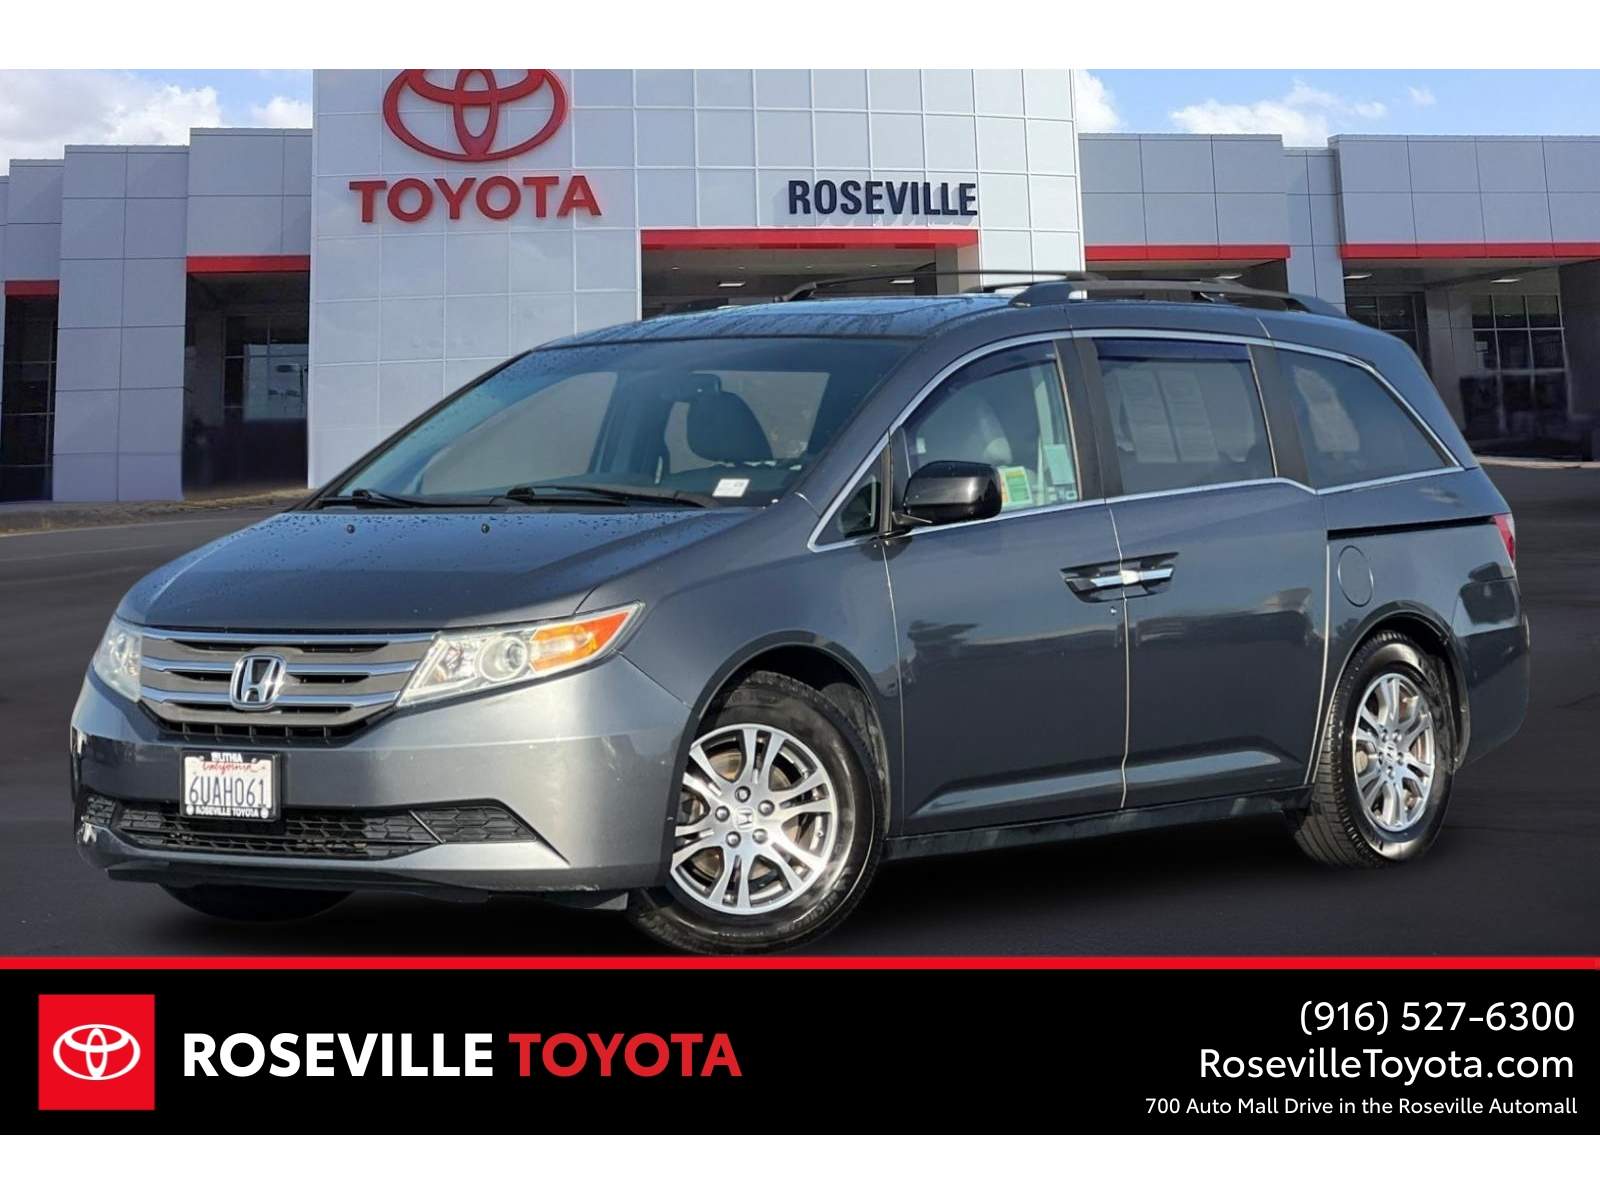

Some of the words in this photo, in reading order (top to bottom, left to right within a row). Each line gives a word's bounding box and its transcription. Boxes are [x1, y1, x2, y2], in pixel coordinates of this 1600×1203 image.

[348, 175, 602, 223] TOYOTA
[788, 179, 978, 216] ROSEVILLE
[189, 776, 265, 806] 6UAH061
